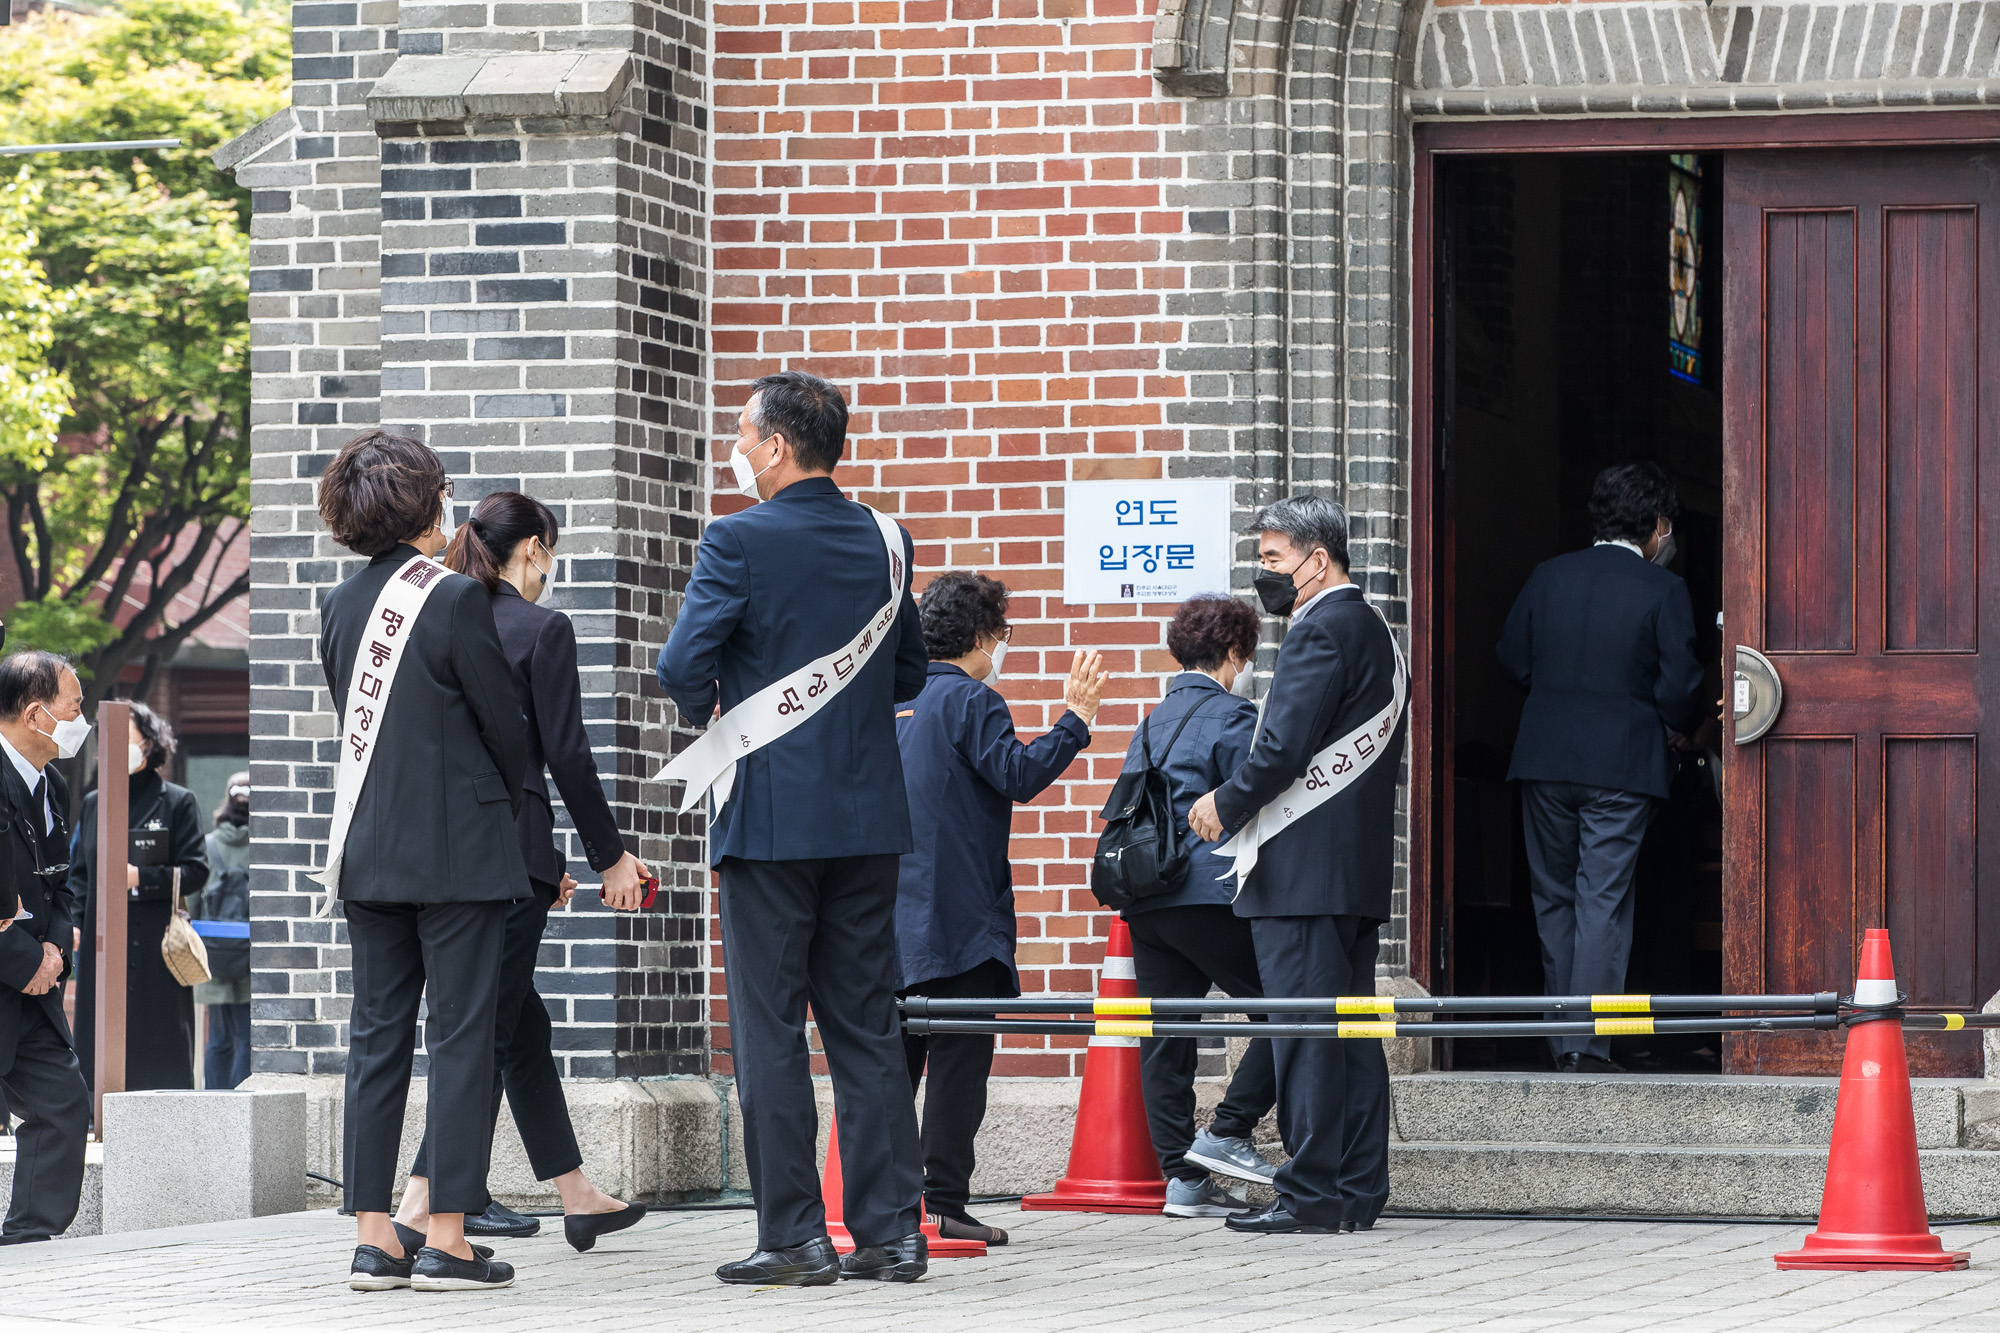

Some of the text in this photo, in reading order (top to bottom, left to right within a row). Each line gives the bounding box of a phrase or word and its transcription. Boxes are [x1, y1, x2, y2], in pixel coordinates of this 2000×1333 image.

[1116, 500, 1178, 525] 연도
[1099, 544, 1194, 573] 입장문
[777, 606, 893, 716] 명동대성당
[349, 607, 405, 762] 명동대성당
[740, 734, 751, 748] 46
[1283, 807, 1294, 819] 45
